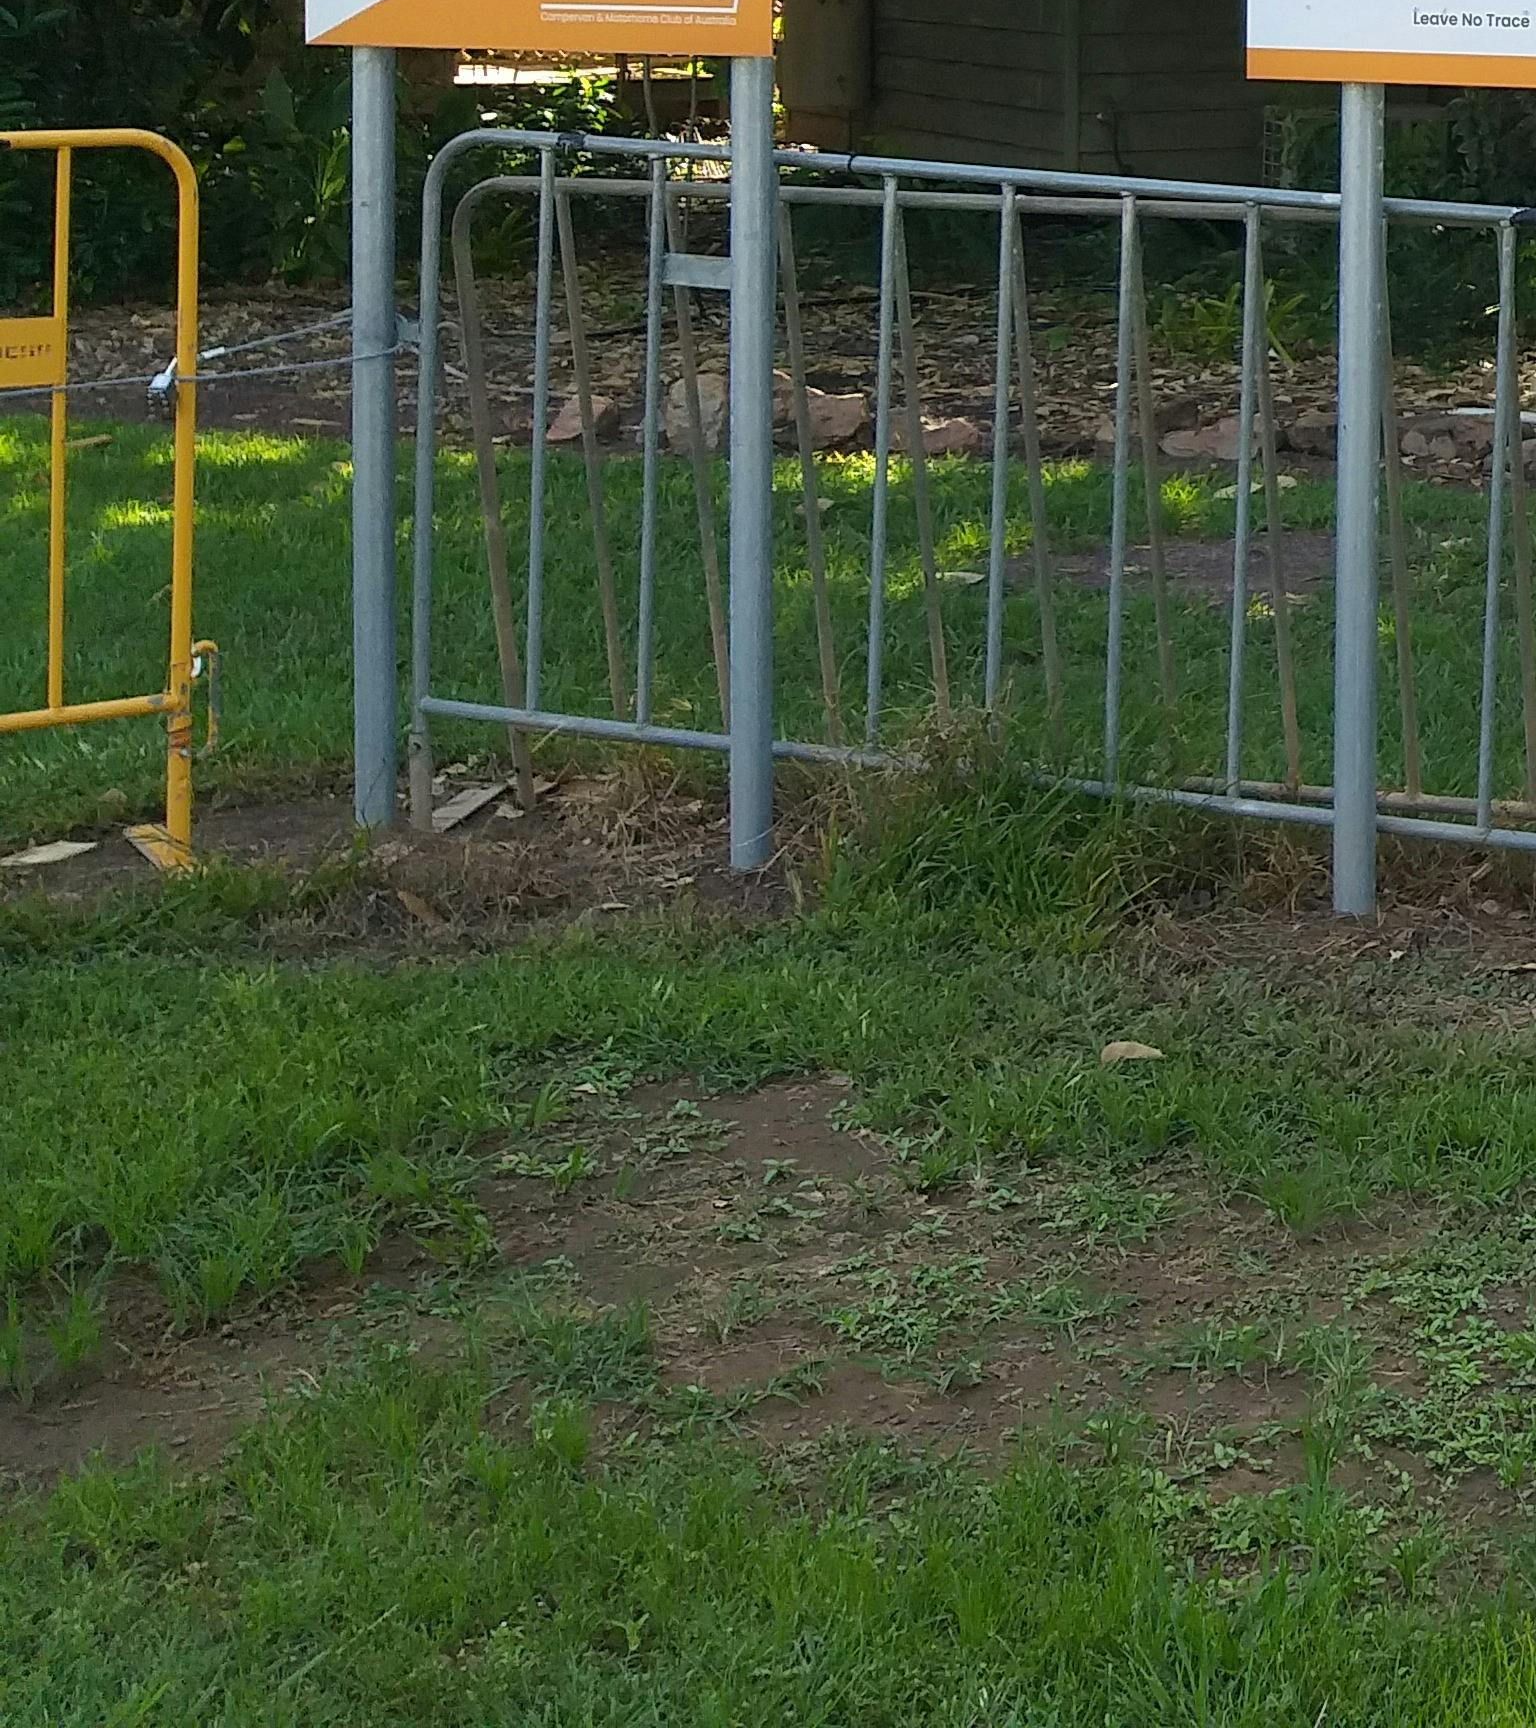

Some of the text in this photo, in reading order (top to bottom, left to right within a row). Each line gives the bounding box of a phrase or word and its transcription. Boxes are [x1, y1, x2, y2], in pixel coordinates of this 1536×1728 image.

[1413, 11, 1530, 27] Leave No Trace
